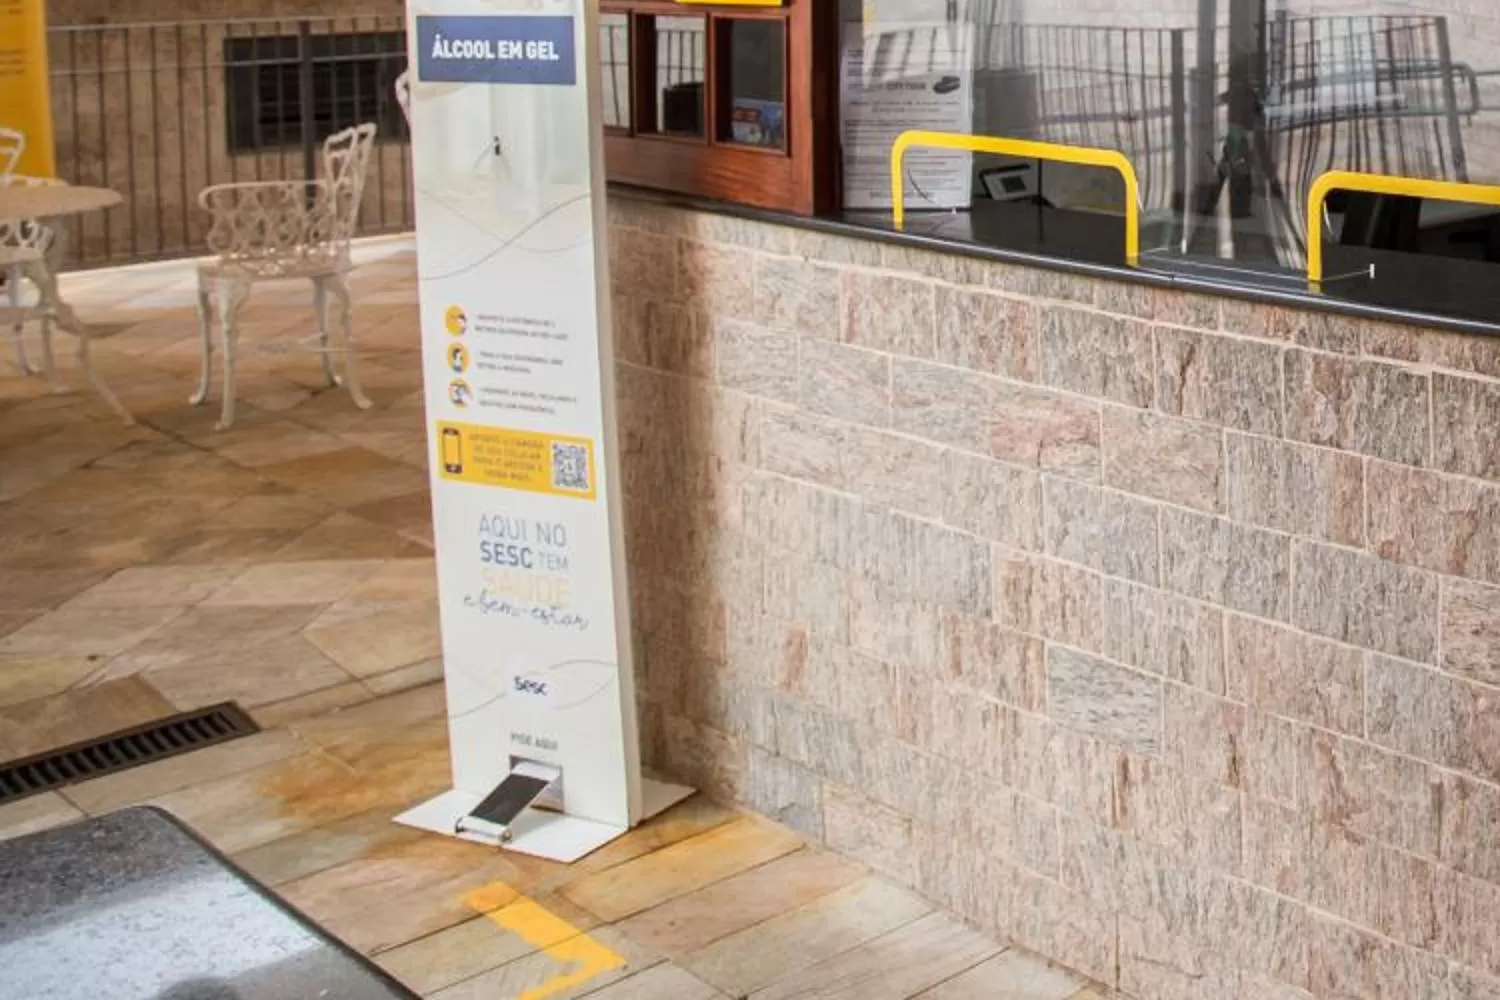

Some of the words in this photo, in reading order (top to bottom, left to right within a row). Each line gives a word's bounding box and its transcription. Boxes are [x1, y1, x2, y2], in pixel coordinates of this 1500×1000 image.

[432, 33, 495, 60] ÁLCOOL
[498, 40, 523, 60] EM
[526, 41, 560, 61] GEL
[479, 512, 528, 541] AQUI
[536, 520, 567, 547] NO
[480, 539, 533, 569] SESC
[538, 551, 569, 571] TEM
